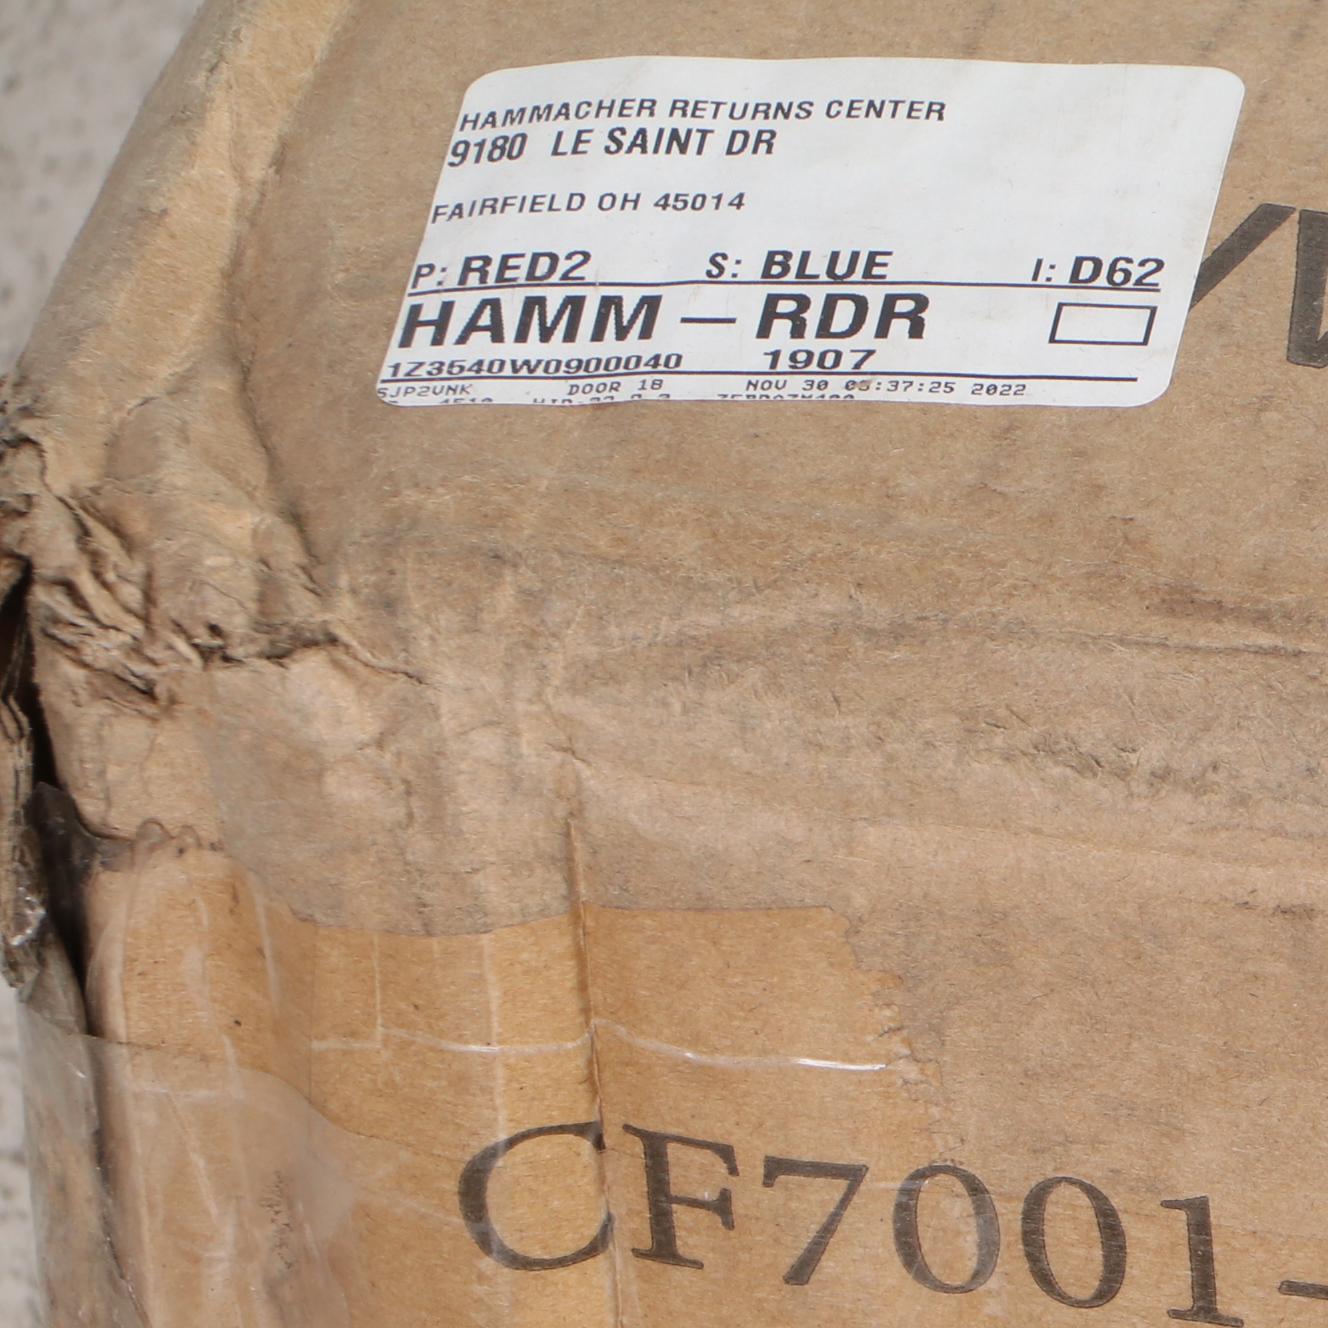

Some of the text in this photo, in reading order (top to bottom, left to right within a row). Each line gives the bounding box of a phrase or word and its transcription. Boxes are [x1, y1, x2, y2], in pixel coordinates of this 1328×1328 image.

[460, 98, 946, 131] HAMMACHER RETURNS CENTER
[447, 127, 777, 167] 9180 LE SAINT DR
[431, 192, 746, 224] FAIRFIELD OH 45014
[411, 250, 1165, 289] P: RED2 S: BLUE I: D62
[398, 294, 663, 349] HAMM
[755, 293, 930, 339] RDR
[763, 349, 876, 370] 1907
[567, 381, 621, 396] DOOR
[637, 378, 663, 391] 18
[745, 379, 787, 391] NOV
[801, 379, 829, 391] 30
[970, 383, 1026, 396] 2022
